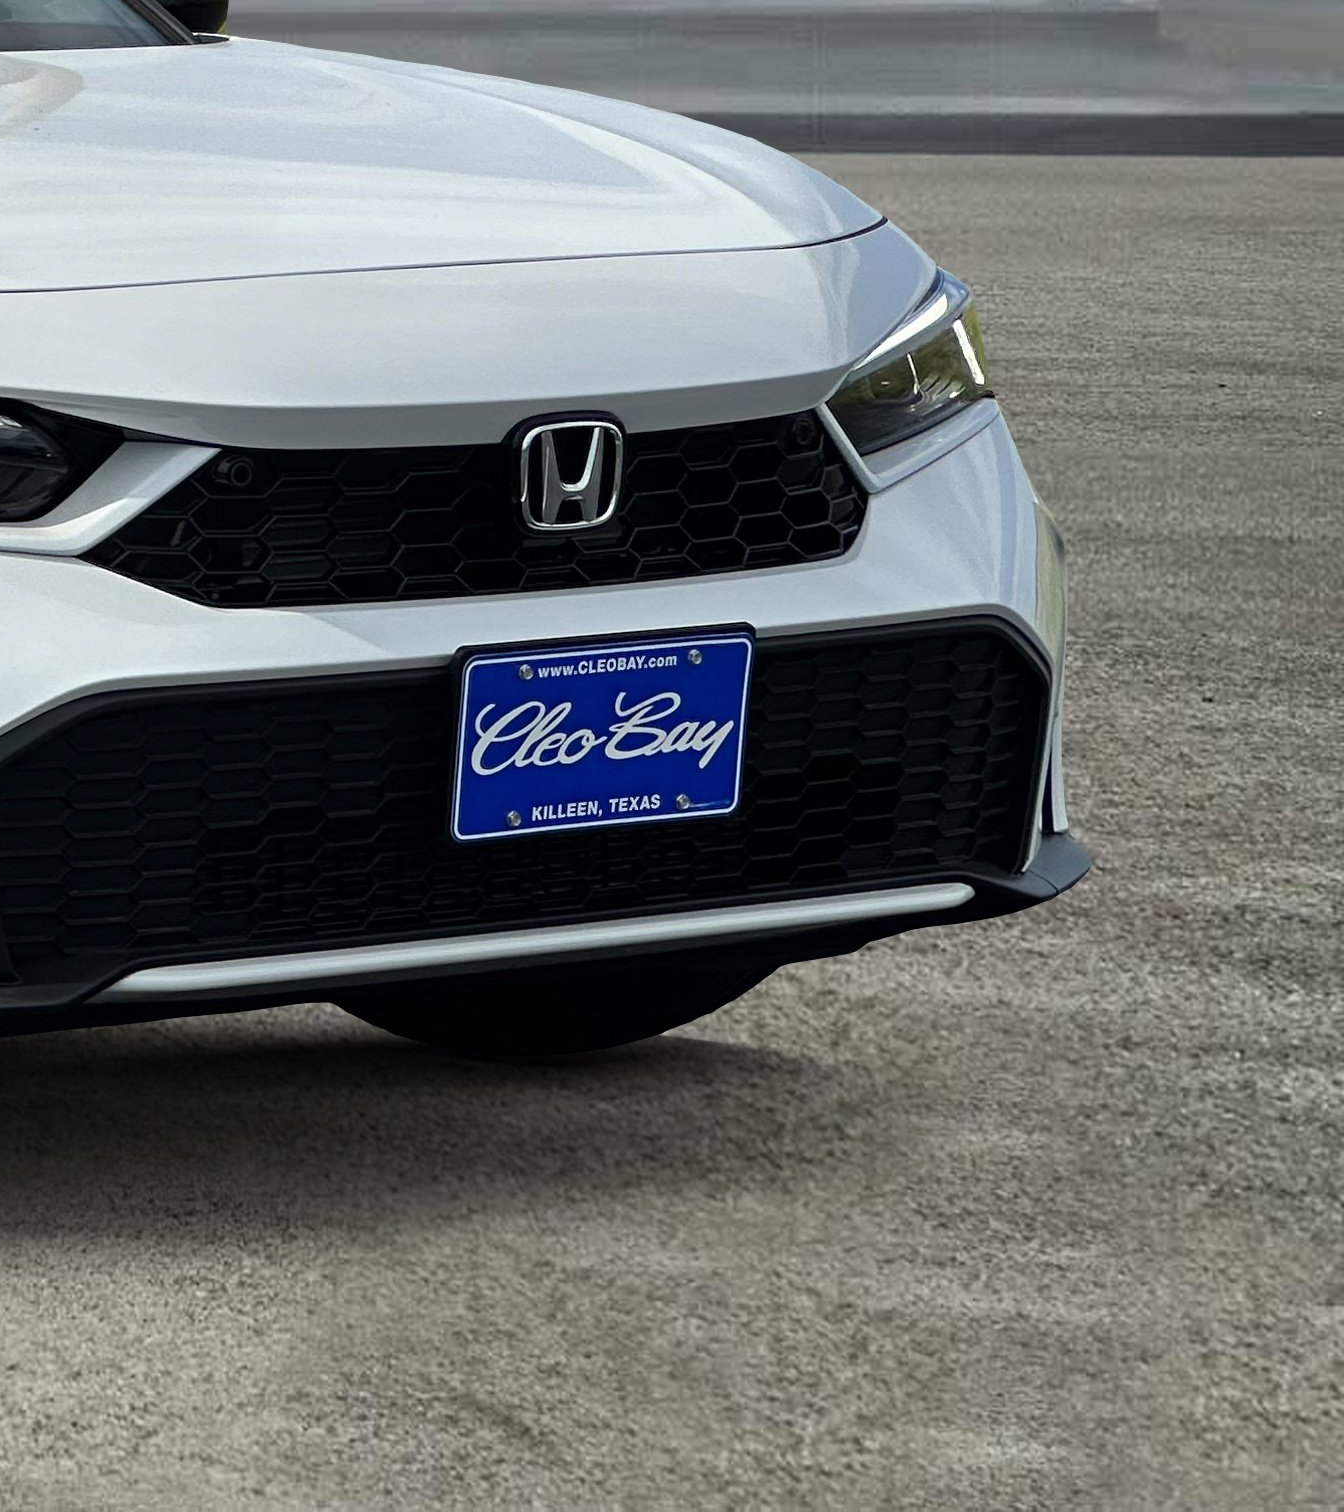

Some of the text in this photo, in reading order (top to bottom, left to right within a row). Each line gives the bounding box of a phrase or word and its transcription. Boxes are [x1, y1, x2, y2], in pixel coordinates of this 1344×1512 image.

[537, 654, 678, 679] www.CLEOBAY.com
[470, 691, 735, 776] Cleo Bay
[531, 793, 661, 822] KILLEEN, TEXAS
